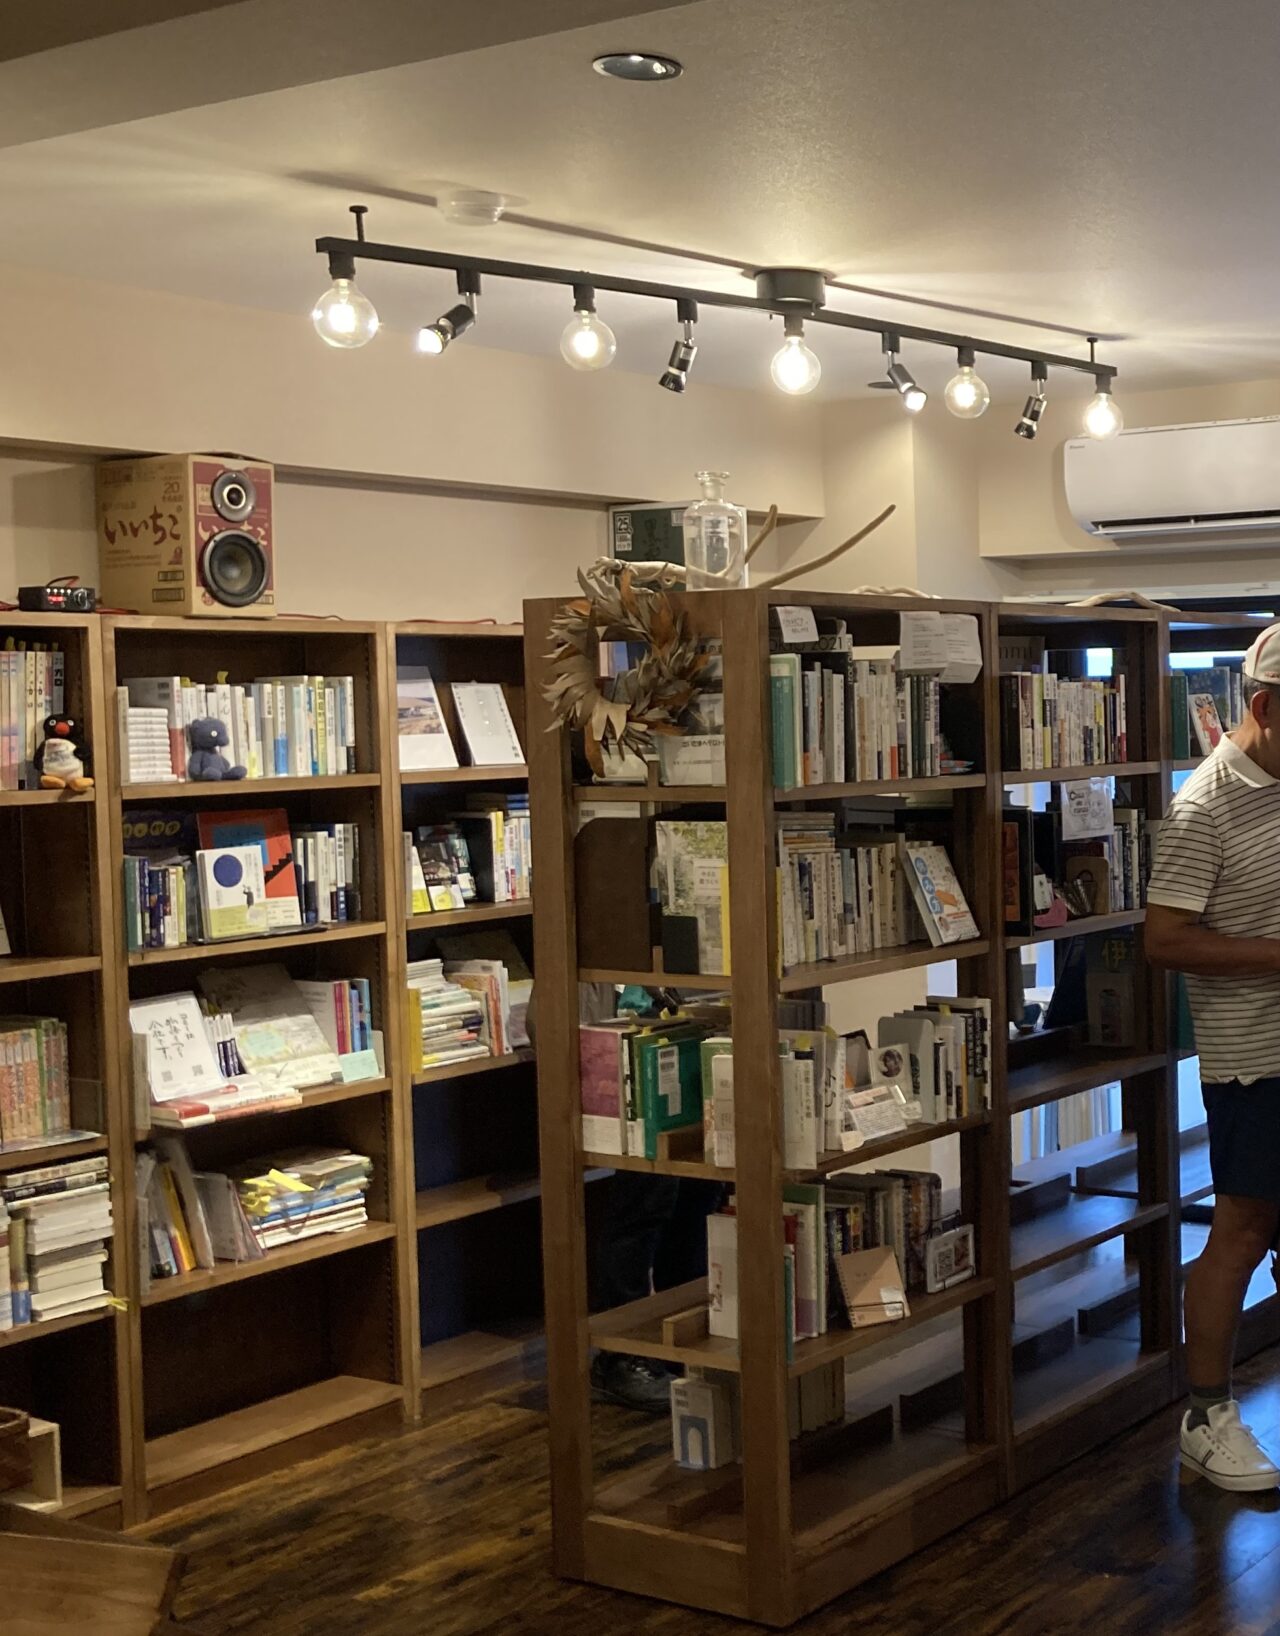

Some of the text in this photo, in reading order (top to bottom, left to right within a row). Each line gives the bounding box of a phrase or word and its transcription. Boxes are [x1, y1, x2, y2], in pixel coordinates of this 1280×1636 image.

[164, 481, 180, 494] 20
[103, 505, 182, 546] いいちこ
